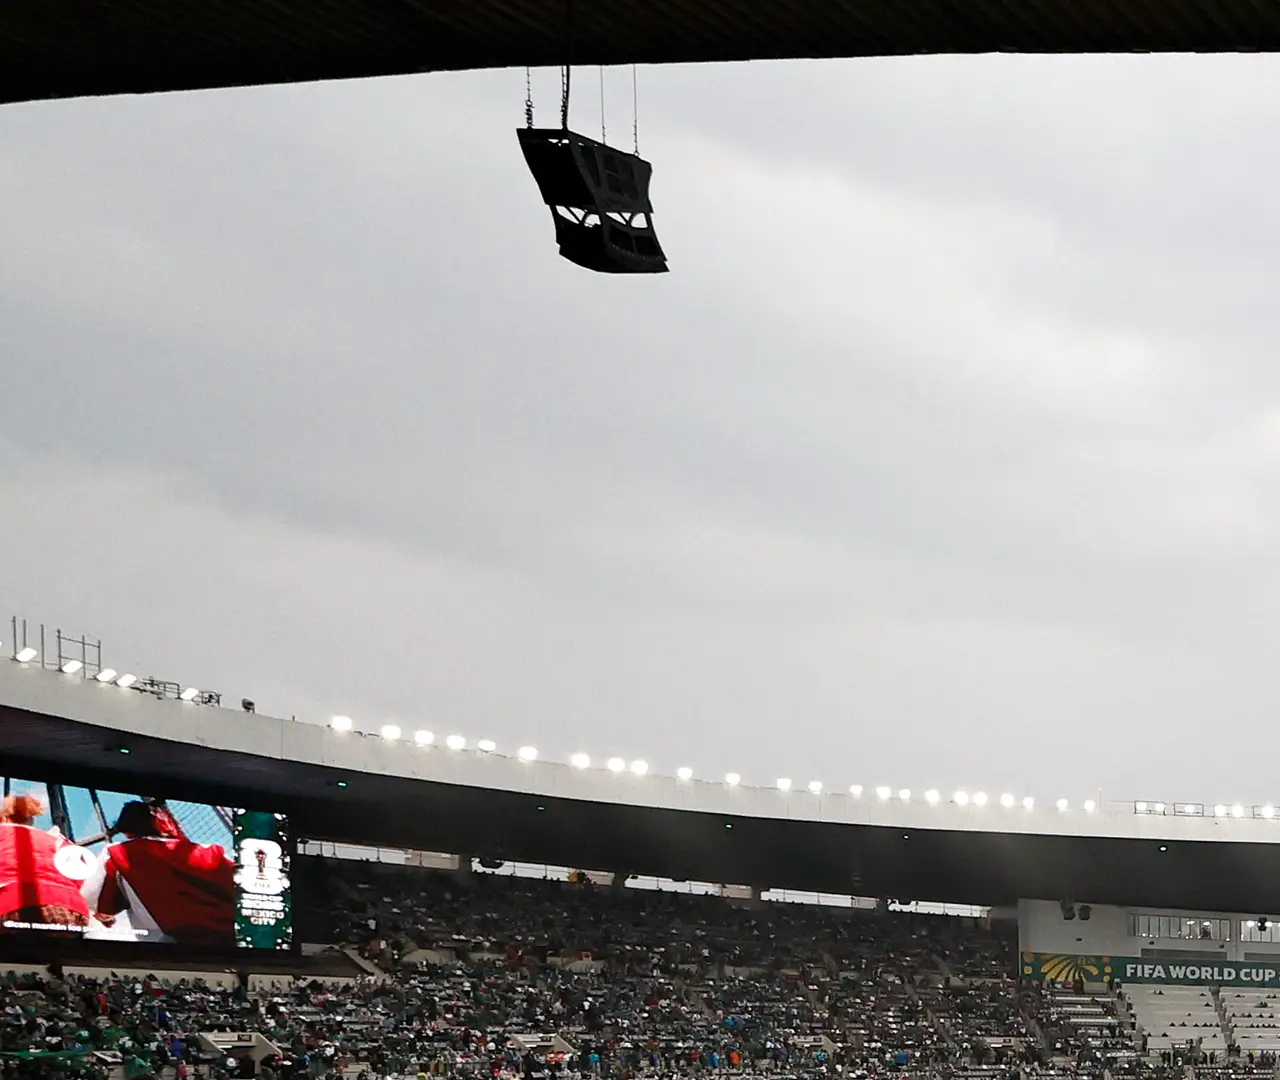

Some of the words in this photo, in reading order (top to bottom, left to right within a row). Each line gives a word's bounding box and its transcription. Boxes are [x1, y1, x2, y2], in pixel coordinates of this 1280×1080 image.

[1126, 963, 1166, 980] FIFA
[1169, 965, 1237, 982] WORLD
[1240, 968, 1276, 983] CUP
